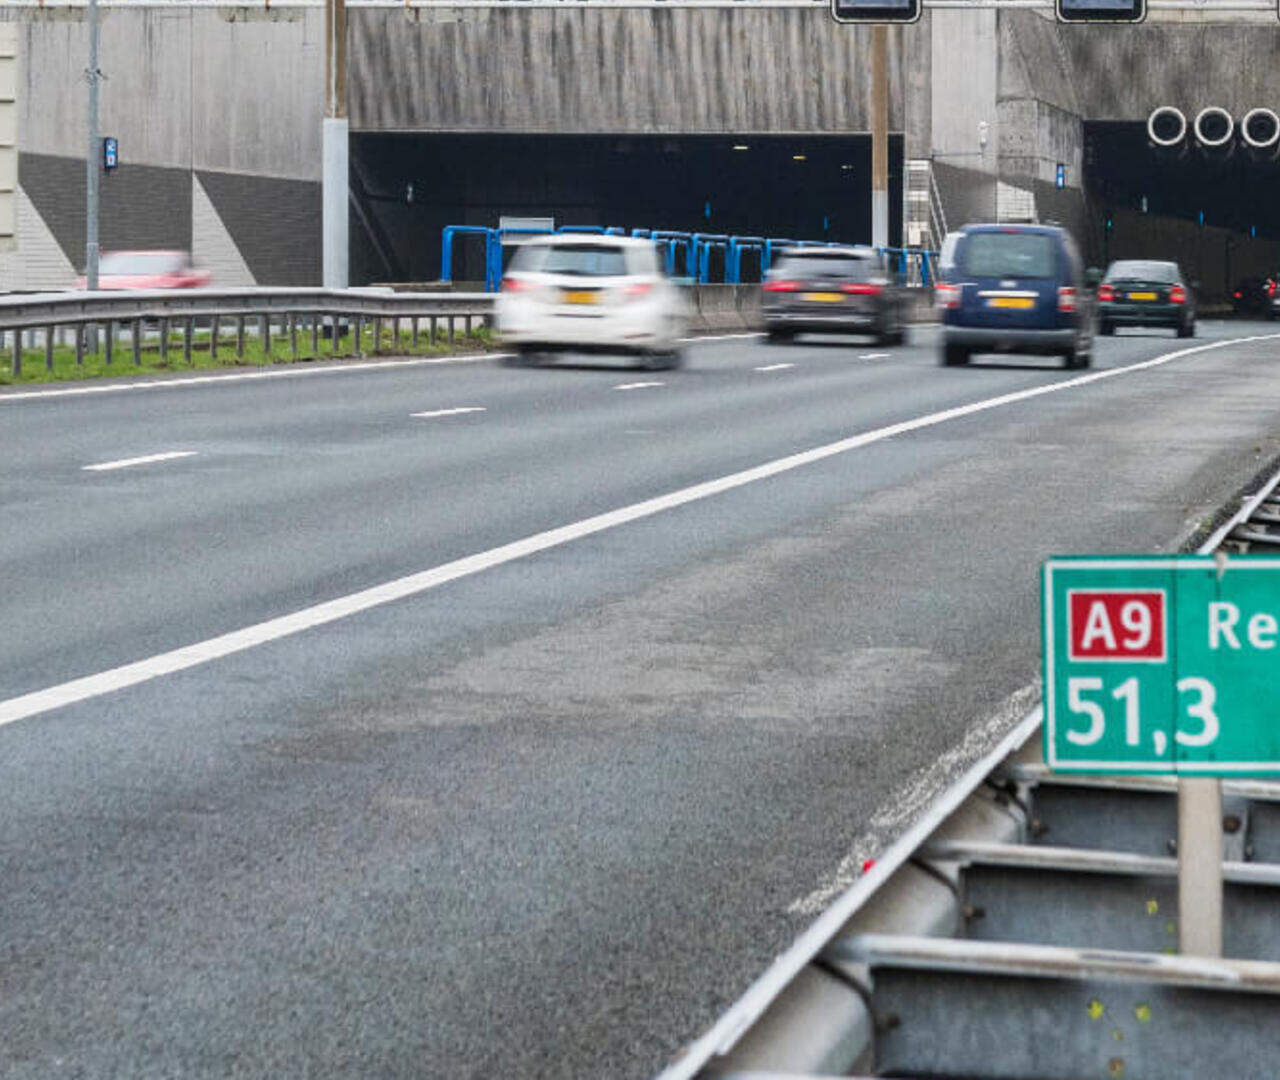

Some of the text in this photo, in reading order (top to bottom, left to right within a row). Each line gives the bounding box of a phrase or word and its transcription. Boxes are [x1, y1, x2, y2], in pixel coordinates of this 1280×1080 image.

[1081, 600, 1279, 650] A9 Re
[1066, 677, 1220, 756] 51,3
